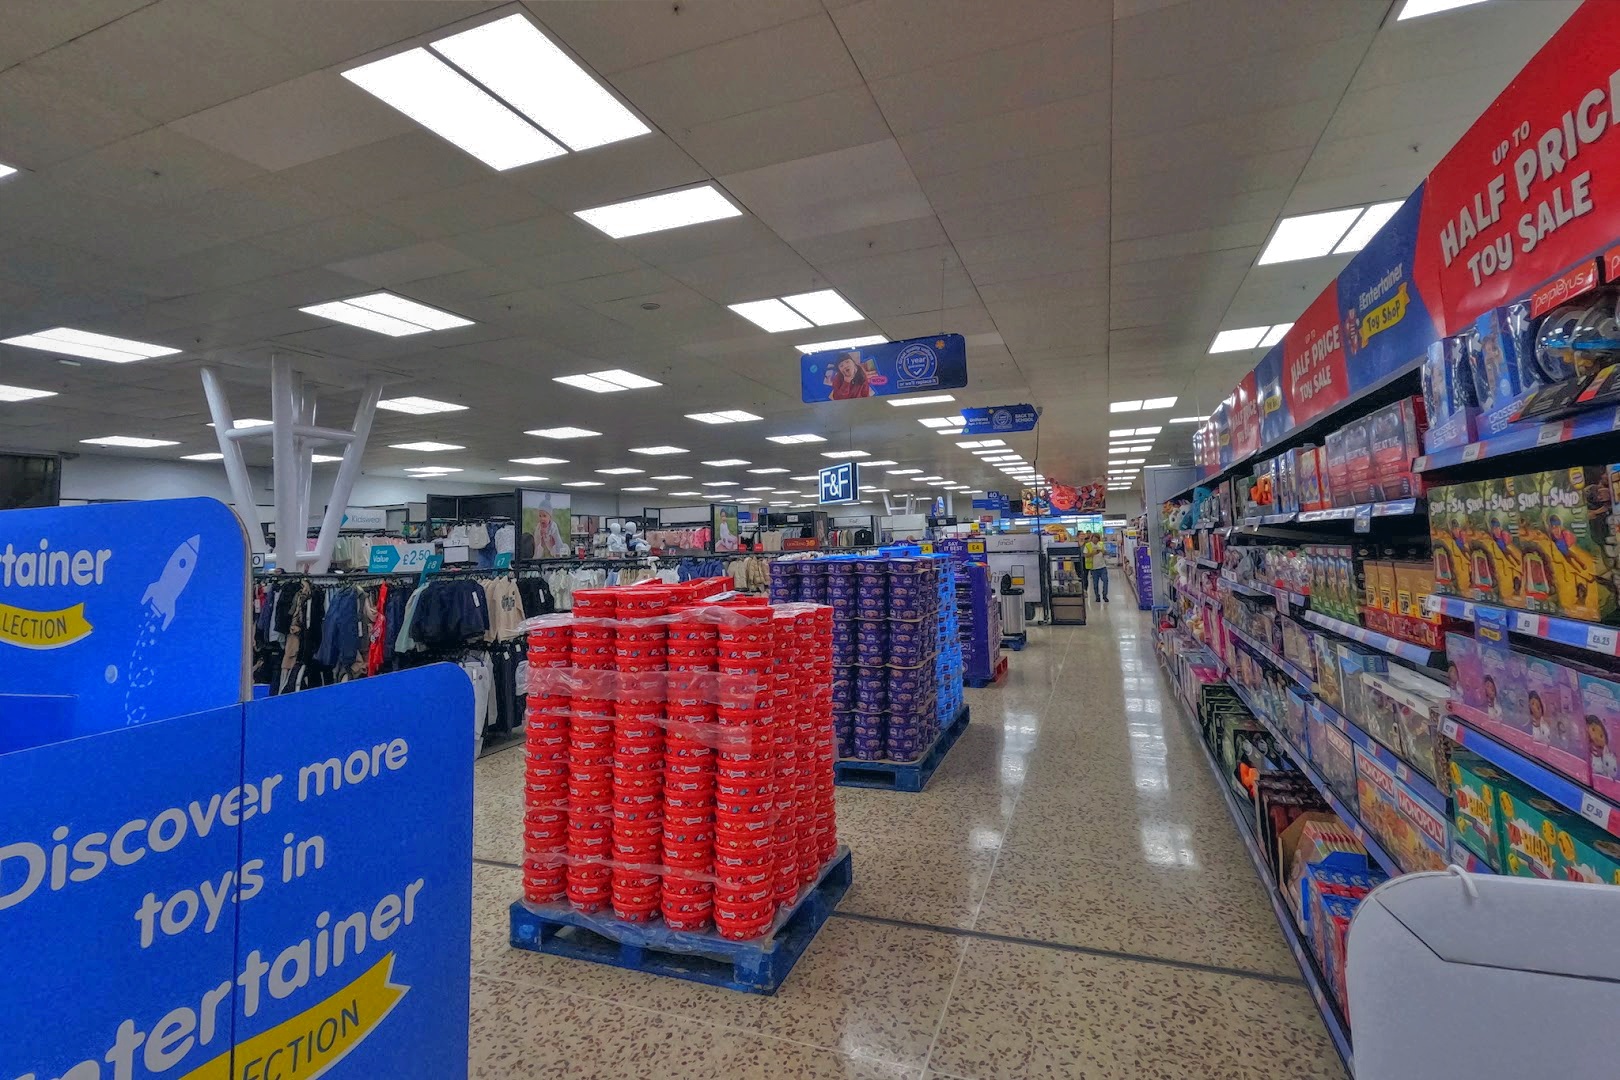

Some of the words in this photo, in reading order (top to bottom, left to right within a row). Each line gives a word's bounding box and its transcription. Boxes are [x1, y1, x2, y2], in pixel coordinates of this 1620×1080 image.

[1493, 141, 1509, 165] UP
[1512, 121, 1530, 146] TO
[1440, 175, 1506, 267] HALF
[1519, 170, 1593, 253] SALE
[1361, 263, 1403, 309] Entertainer
[1367, 315, 1381, 332] Toy
[911, 357, 926, 366] year
[1291, 351, 1310, 386] HALF
[1312, 324, 1341, 368] PRICE
[1313, 365, 1332, 394] SALE
[821, 469, 849, 497] F&F
[1518, 492, 1541, 512] SINK
[1551, 486, 1580, 507] SAND
[0, 538, 112, 588] tainer
[373, 555, 389, 563] Value
[402, 550, 431, 566] £2.50
[427, 560, 437, 569] £8
[0, 612, 67, 639] LECTION
[0, 773, 283, 910] Discover
[298, 737, 409, 802] more
[1399, 790, 1444, 845] MONOPOLY
[134, 858, 264, 949] toys
[282, 833, 325, 883] in
[10, 878, 425, 1080] tertainer
